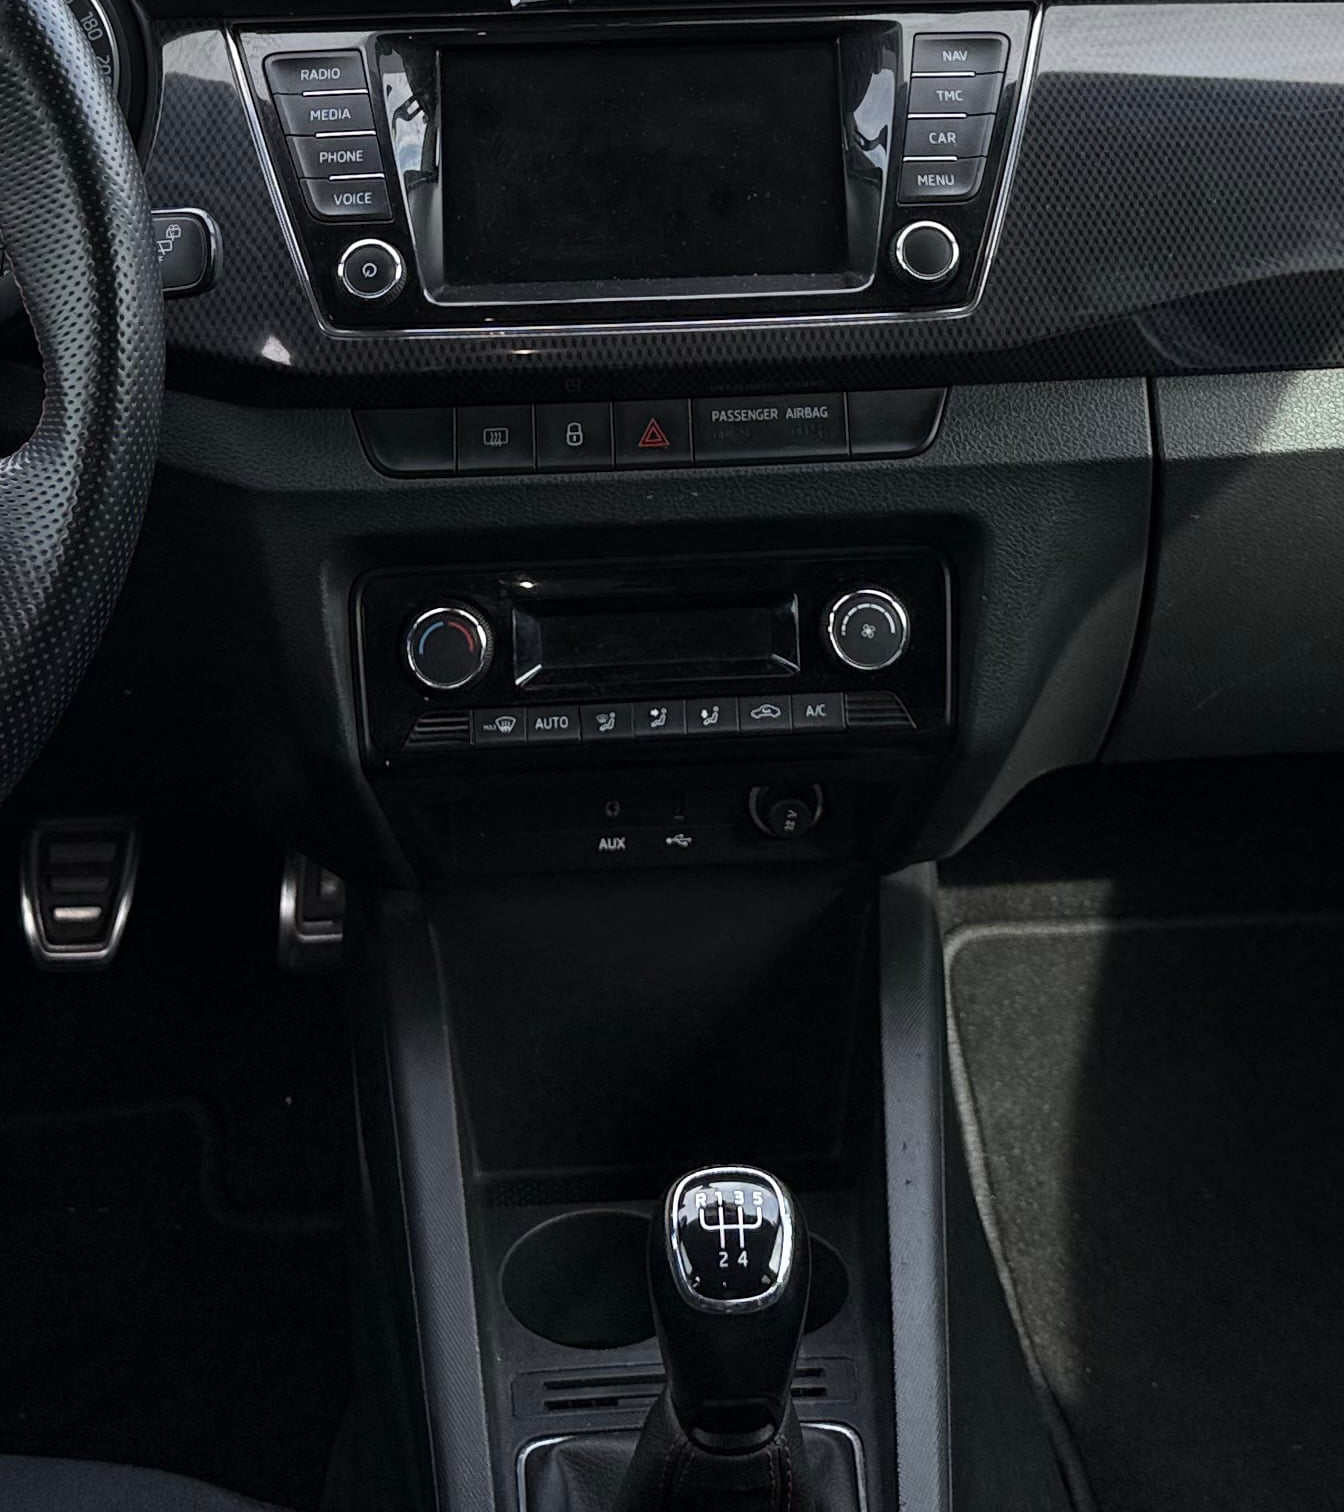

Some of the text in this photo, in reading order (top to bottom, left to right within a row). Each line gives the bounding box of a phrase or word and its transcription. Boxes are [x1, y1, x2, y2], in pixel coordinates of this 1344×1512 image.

[80, 11, 103, 41] 180
[942, 50, 968, 62] NAV
[300, 67, 341, 81] RADIO
[936, 90, 963, 102] TMC
[310, 108, 351, 121] MEDIA
[928, 132, 957, 144] CAR
[319, 149, 364, 164] PHONE
[917, 174, 955, 186] MENU
[333, 191, 373, 205] VOICE
[711, 406, 829, 422] PASSENGER AIRBAG
[806, 704, 826, 718] A/C
[535, 716, 569, 730] AUTO
[599, 837, 626, 851] AUX
[695, 1191, 763, 1207] R 1 3 5
[719, 1250, 749, 1268] 2 4
